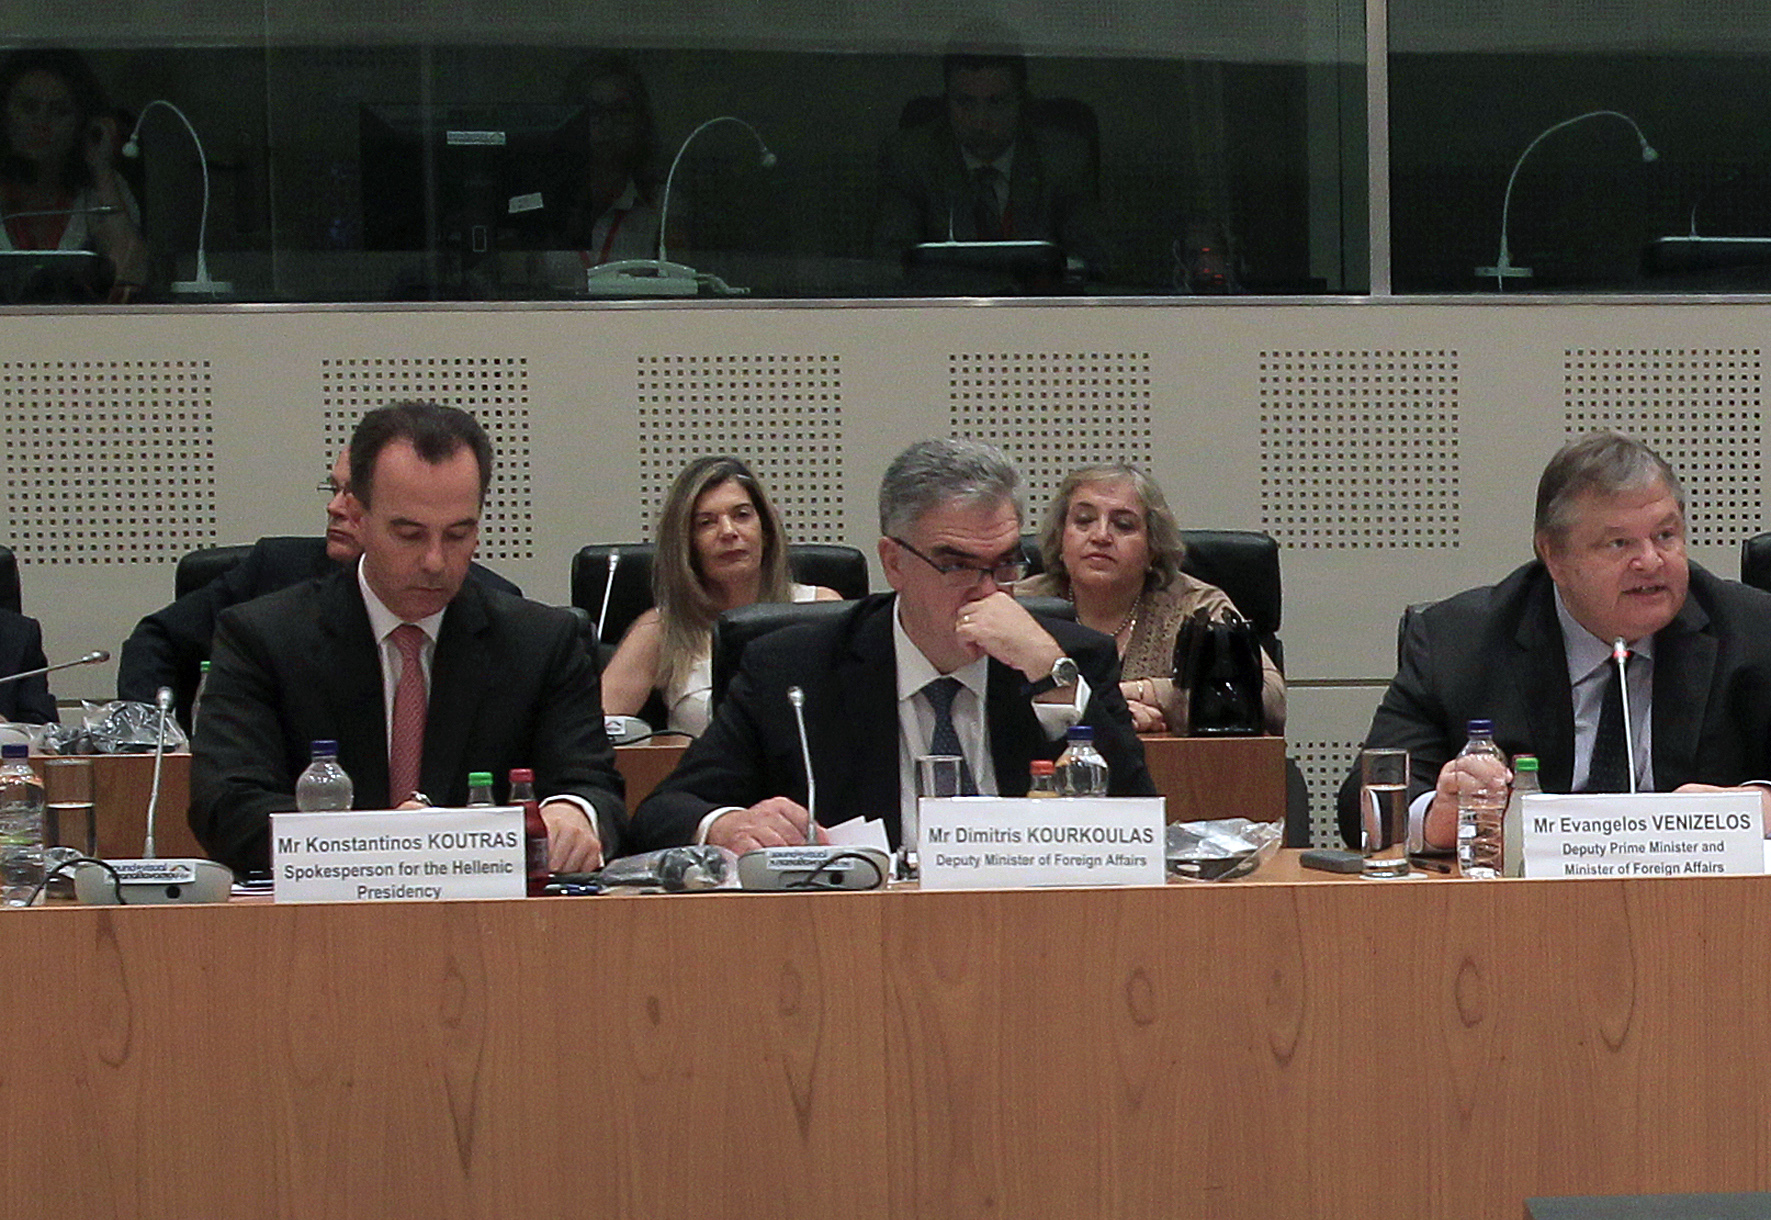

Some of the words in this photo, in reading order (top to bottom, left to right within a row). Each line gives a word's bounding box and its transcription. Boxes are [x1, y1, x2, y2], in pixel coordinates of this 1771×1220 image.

[1534, 818, 1556, 833] Mr
[1561, 816, 1647, 835] Evangelos
[1652, 814, 1751, 831] VENIZELOS
[278, 838, 300, 853] Mr
[306, 835, 422, 852] Konstantinos
[429, 832, 517, 849] KOUTRAS
[929, 828, 950, 843] Mr
[956, 828, 1021, 843] Dimitris
[1027, 827, 1154, 843] KOURKOULAS
[1563, 842, 1606, 857] Deputy
[1610, 841, 1645, 854] Prime
[1650, 841, 1698, 854] Minister
[1702, 840, 1724, 853] and
[936, 854, 980, 868] Deputy
[985, 854, 1034, 866] Minister
[1038, 854, 1051, 866] of
[1055, 853, 1102, 868] Foreign
[1105, 853, 1147, 866] Affairs
[1564, 863, 1613, 875] Minister
[1617, 862, 1631, 874] of
[1633, 862, 1681, 876] Foreign
[1684, 861, 1725, 873] Affairs
[284, 864, 393, 881] Spokesperson
[399, 860, 419, 875] for
[424, 860, 447, 875] the
[453, 859, 512, 874] Hellenic
[358, 884, 441, 899] Presidency
